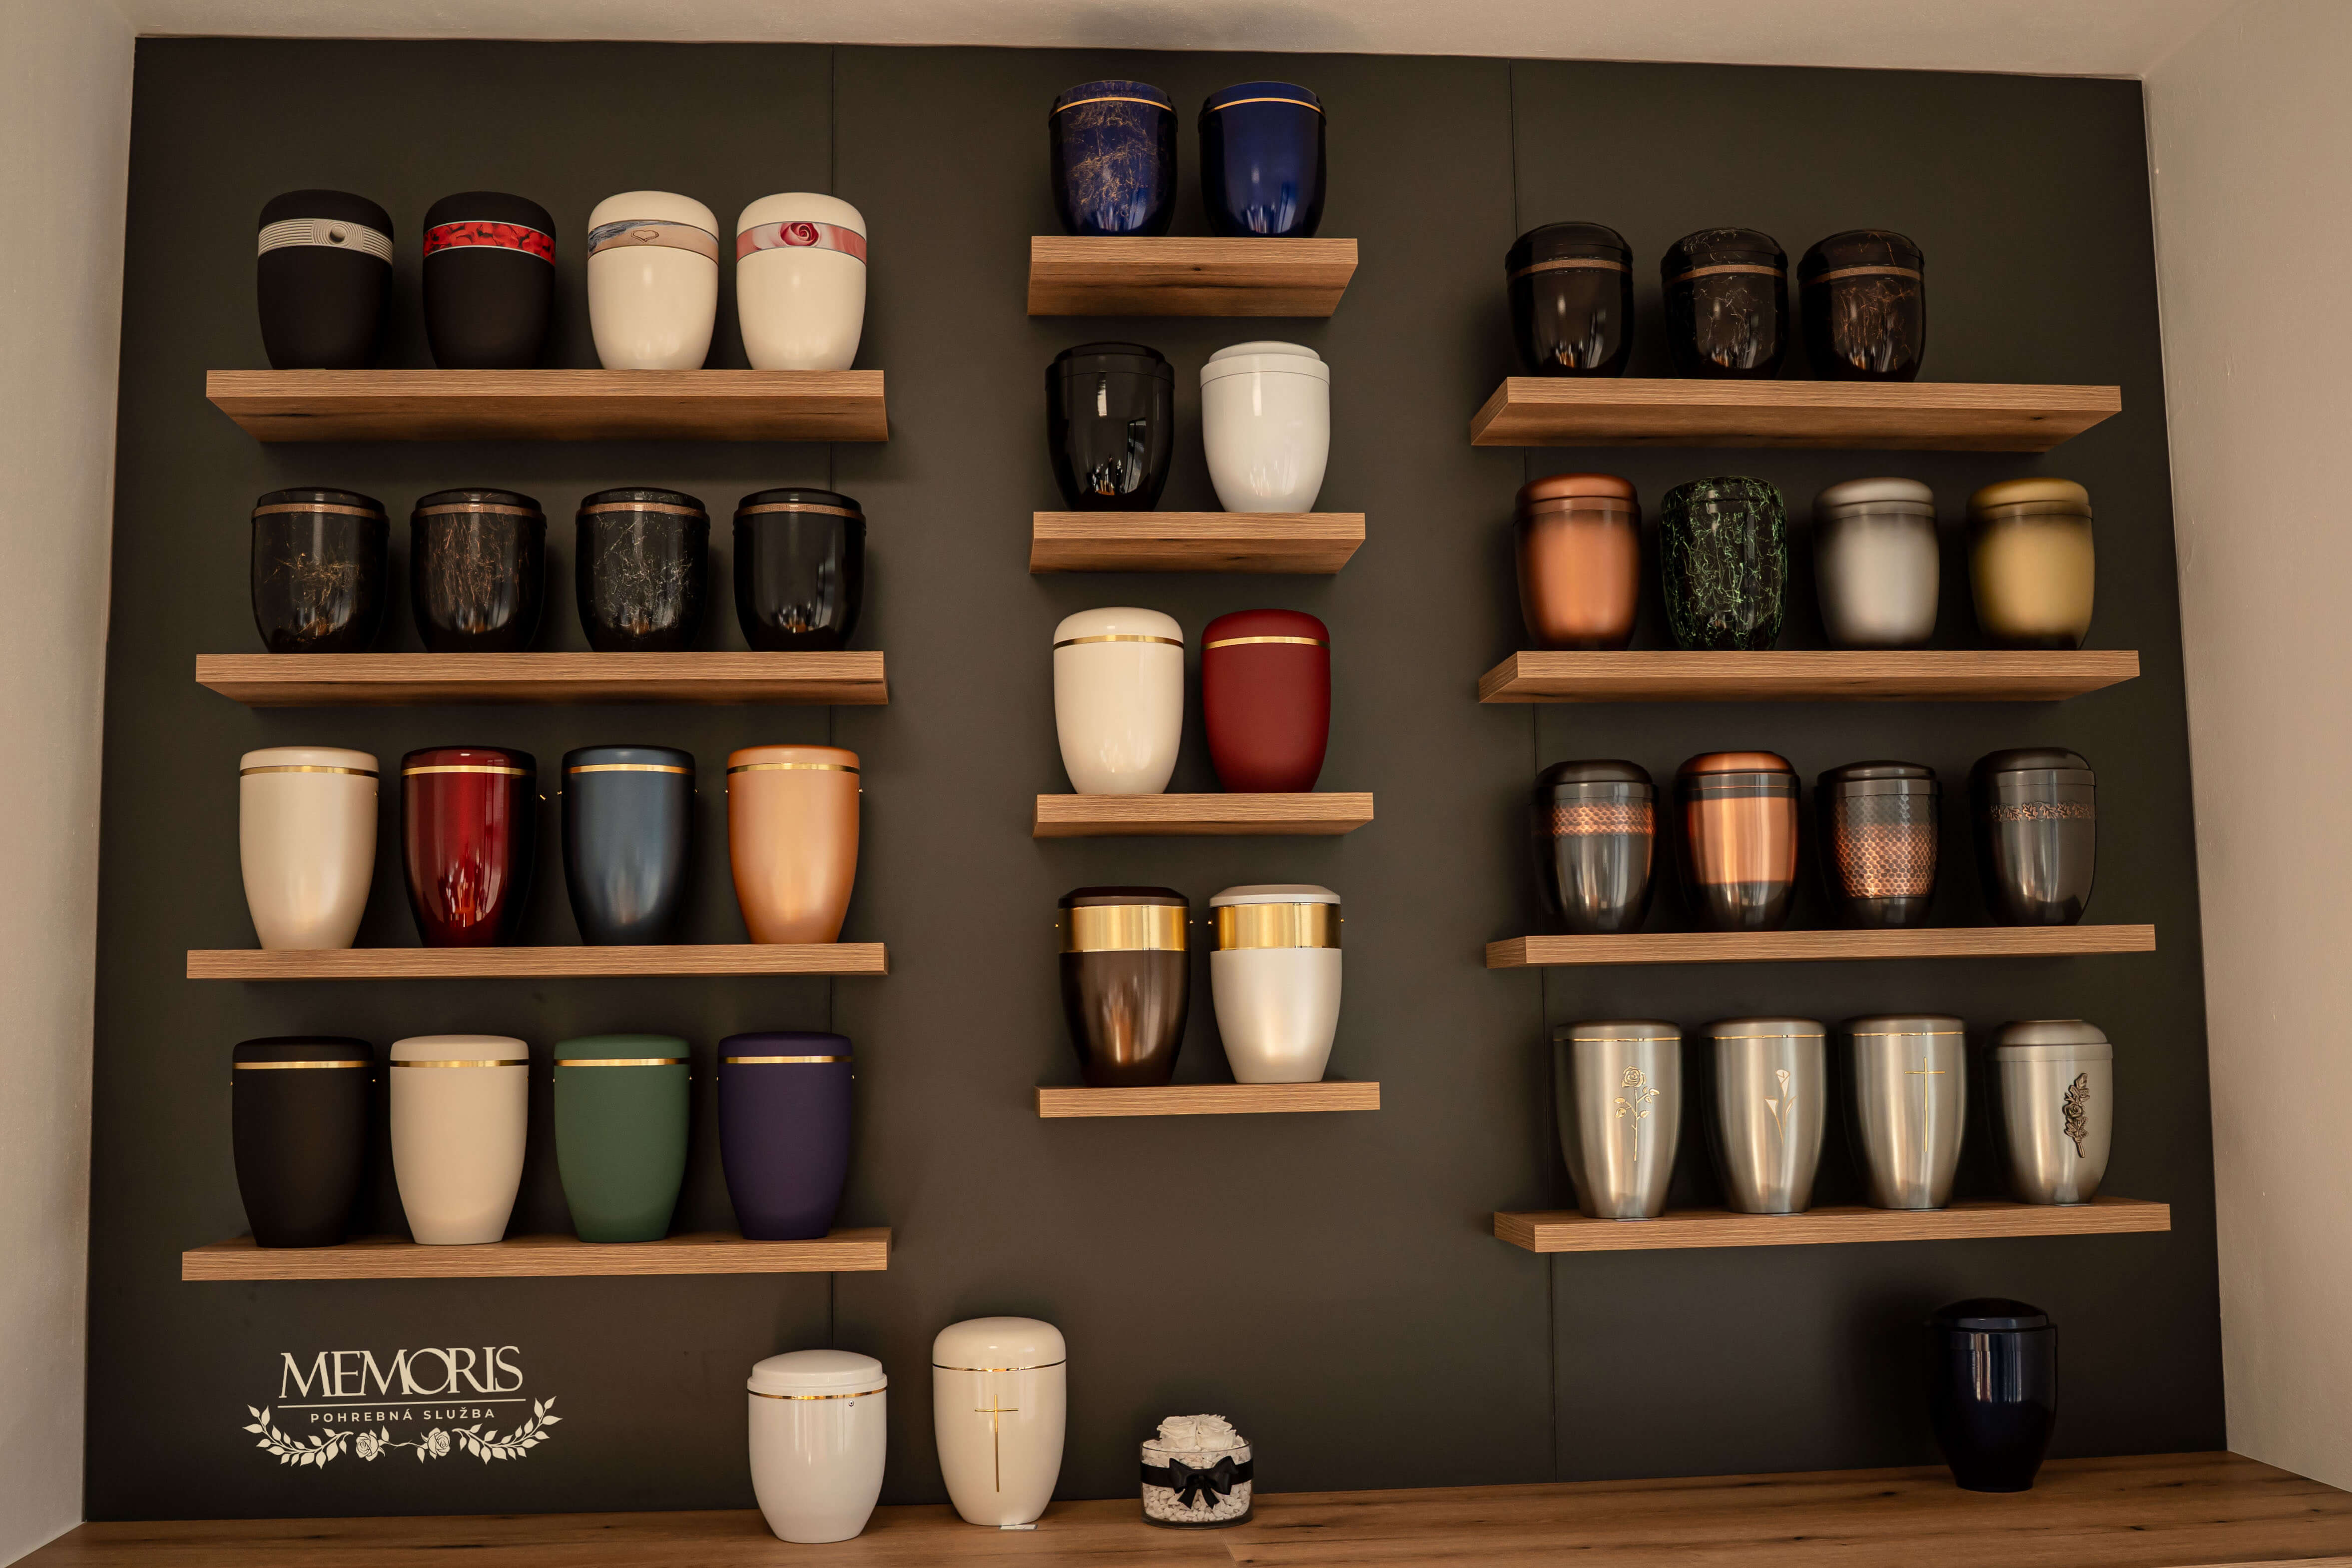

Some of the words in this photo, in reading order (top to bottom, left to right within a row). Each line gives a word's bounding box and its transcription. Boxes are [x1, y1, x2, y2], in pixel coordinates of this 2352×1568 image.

[278, 1346, 523, 1398] MEMORIS
[311, 1408, 413, 1423] POHREBNÁ
[423, 1407, 495, 1420] SLUŽBA
